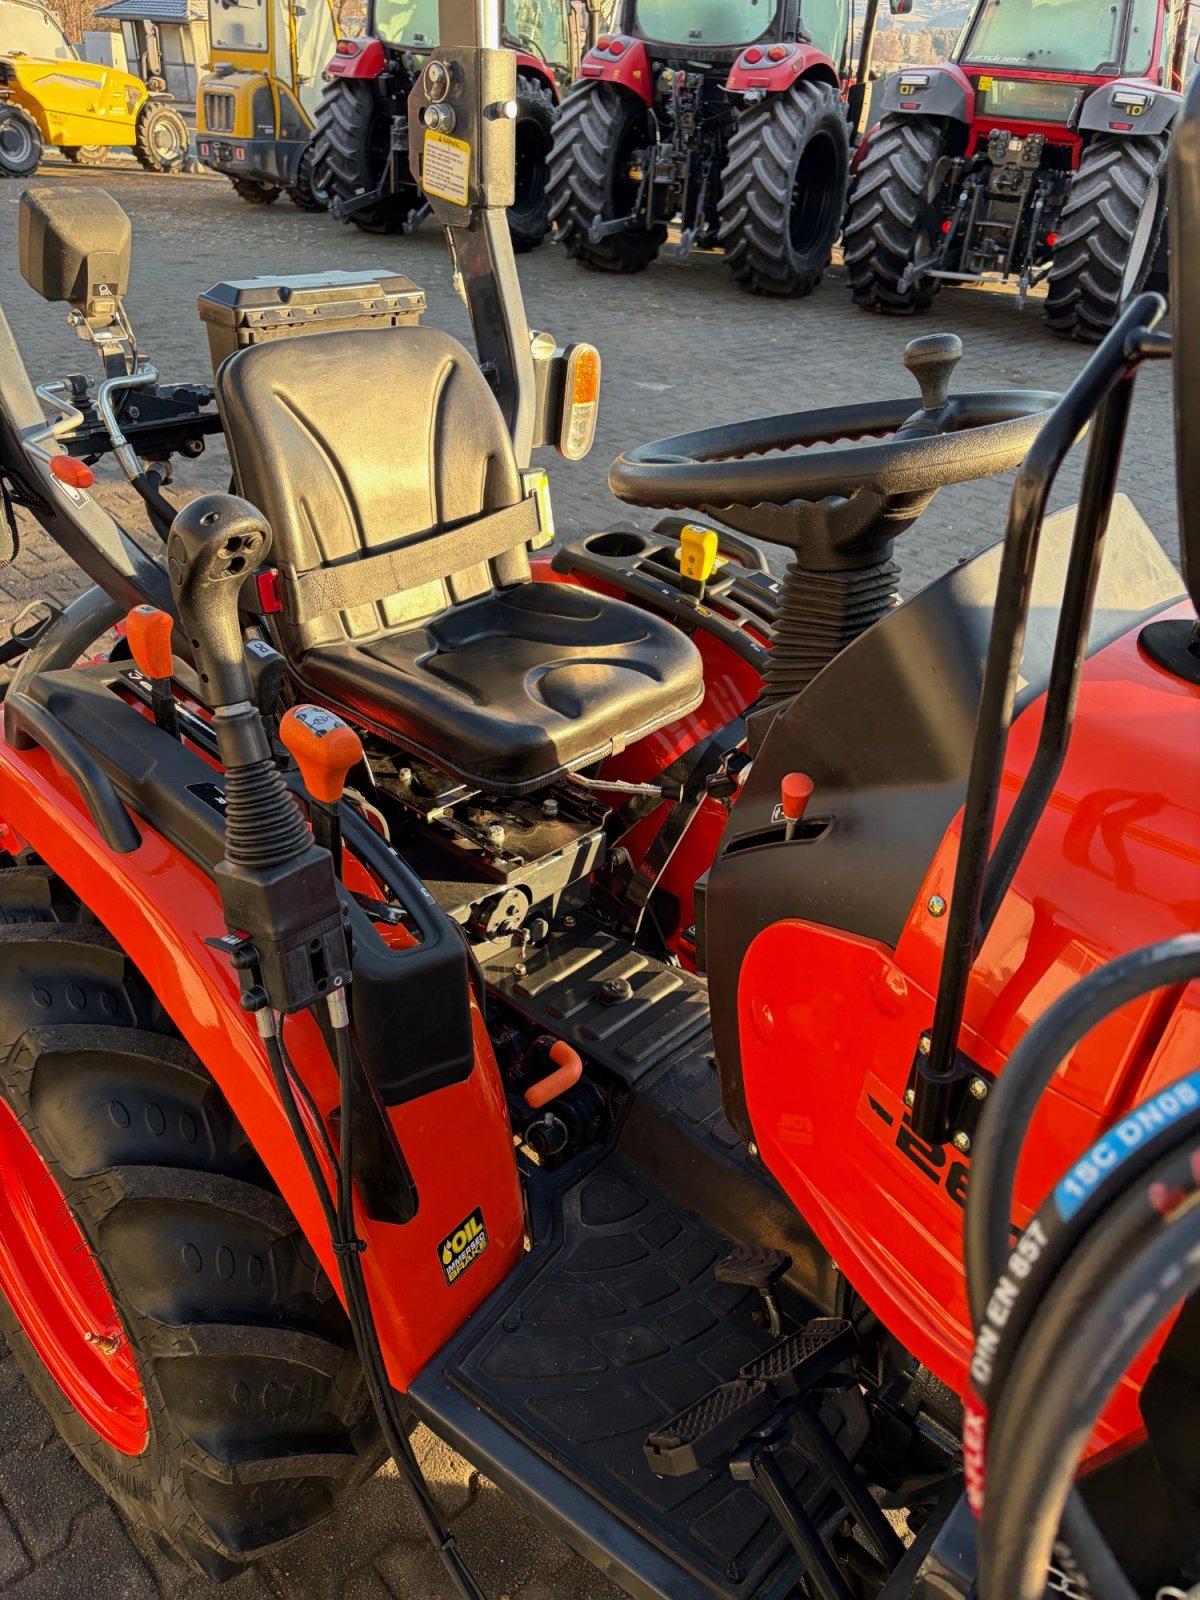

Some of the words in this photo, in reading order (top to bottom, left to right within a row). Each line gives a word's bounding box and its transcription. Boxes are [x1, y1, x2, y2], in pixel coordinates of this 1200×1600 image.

[965, 51, 1027, 63] Lindner
[446, 1231, 485, 1275] IMMERSED
[452, 1216, 484, 1254] OIL
[970, 1323, 1000, 1385] DIN
[986, 1275, 1020, 1327] EN
[1064, 1142, 1118, 1198] 1SC
[1116, 1081, 1199, 1146] DN08
[448, 1238, 488, 1282] BRAKE
